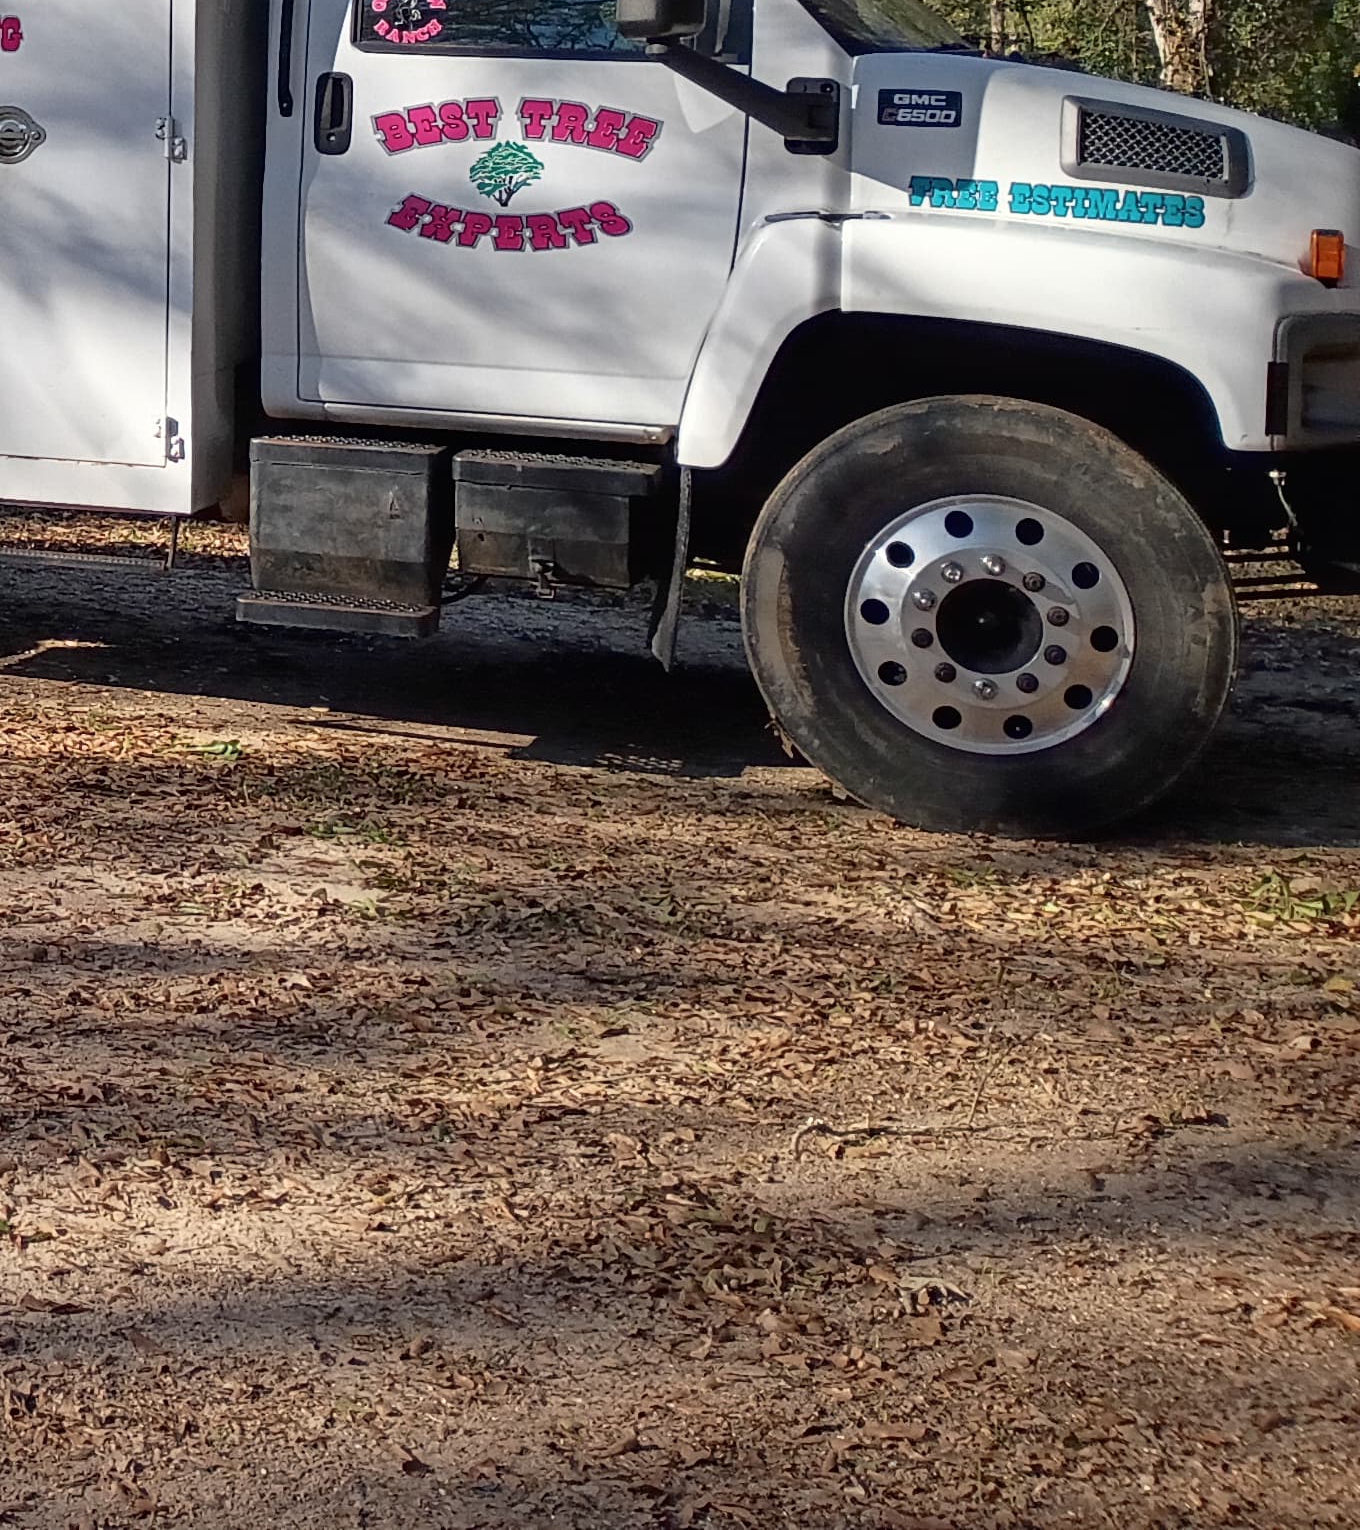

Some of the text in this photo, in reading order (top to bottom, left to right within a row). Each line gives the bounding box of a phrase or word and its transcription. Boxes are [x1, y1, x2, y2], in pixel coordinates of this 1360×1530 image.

[372, 17, 444, 45] RANCH
[881, 107, 957, 123] C6500
[893, 93, 947, 106] GMC
[375, 99, 659, 159] BEST TREE
[388, 194, 631, 251] EXPERTS
[908, 175, 1206, 229] FREE ESTIMATES
